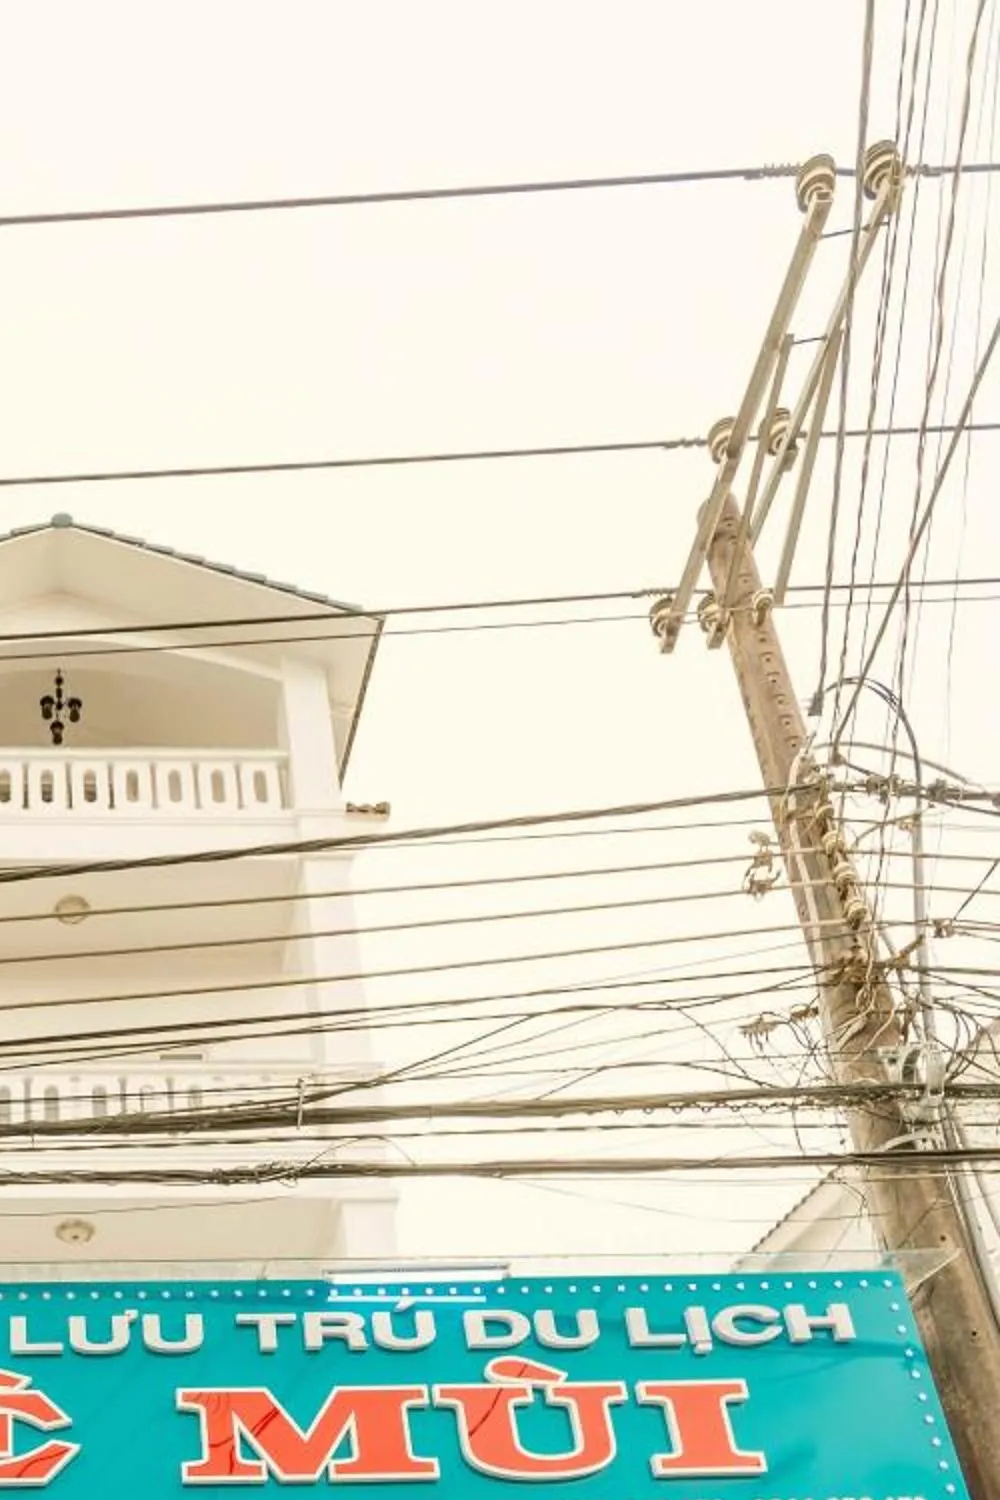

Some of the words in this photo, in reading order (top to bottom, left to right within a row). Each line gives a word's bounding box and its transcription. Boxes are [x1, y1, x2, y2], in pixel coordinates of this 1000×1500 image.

[10, 1309, 205, 1355] LƯU
[236, 1301, 437, 1352] TRÚ
[463, 1308, 601, 1349] DU
[625, 1303, 857, 1354] LỊCH
[176, 1355, 768, 1483] MÙI
